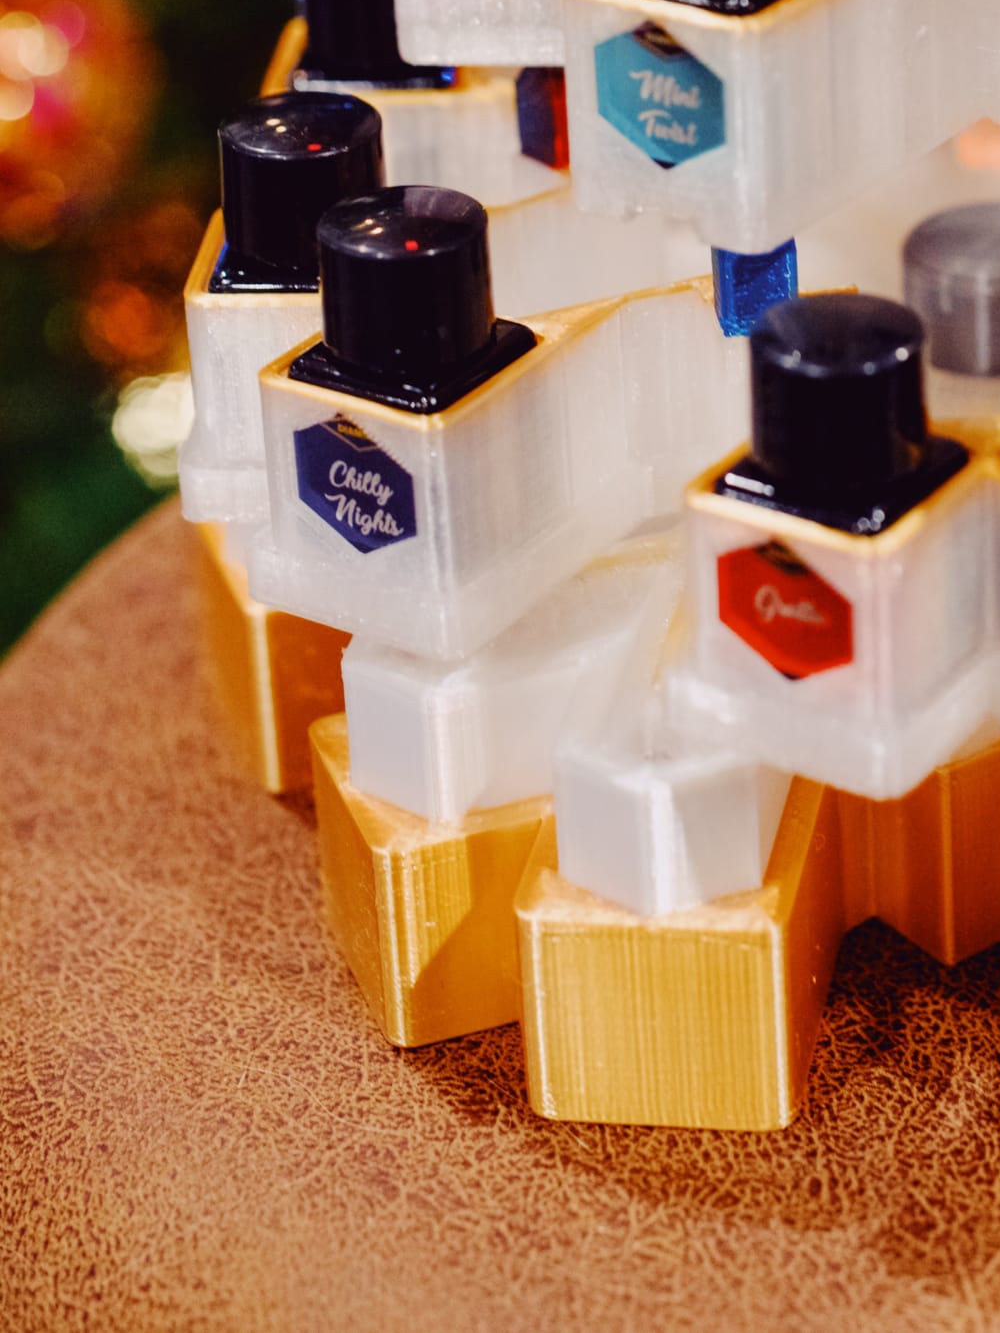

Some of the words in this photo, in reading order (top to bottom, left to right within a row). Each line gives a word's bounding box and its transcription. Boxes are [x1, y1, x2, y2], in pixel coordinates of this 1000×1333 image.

[628, 70, 699, 108] Mint
[638, 109, 696, 145] Twist
[329, 460, 394, 506] Chilly
[324, 493, 404, 537] Nights
